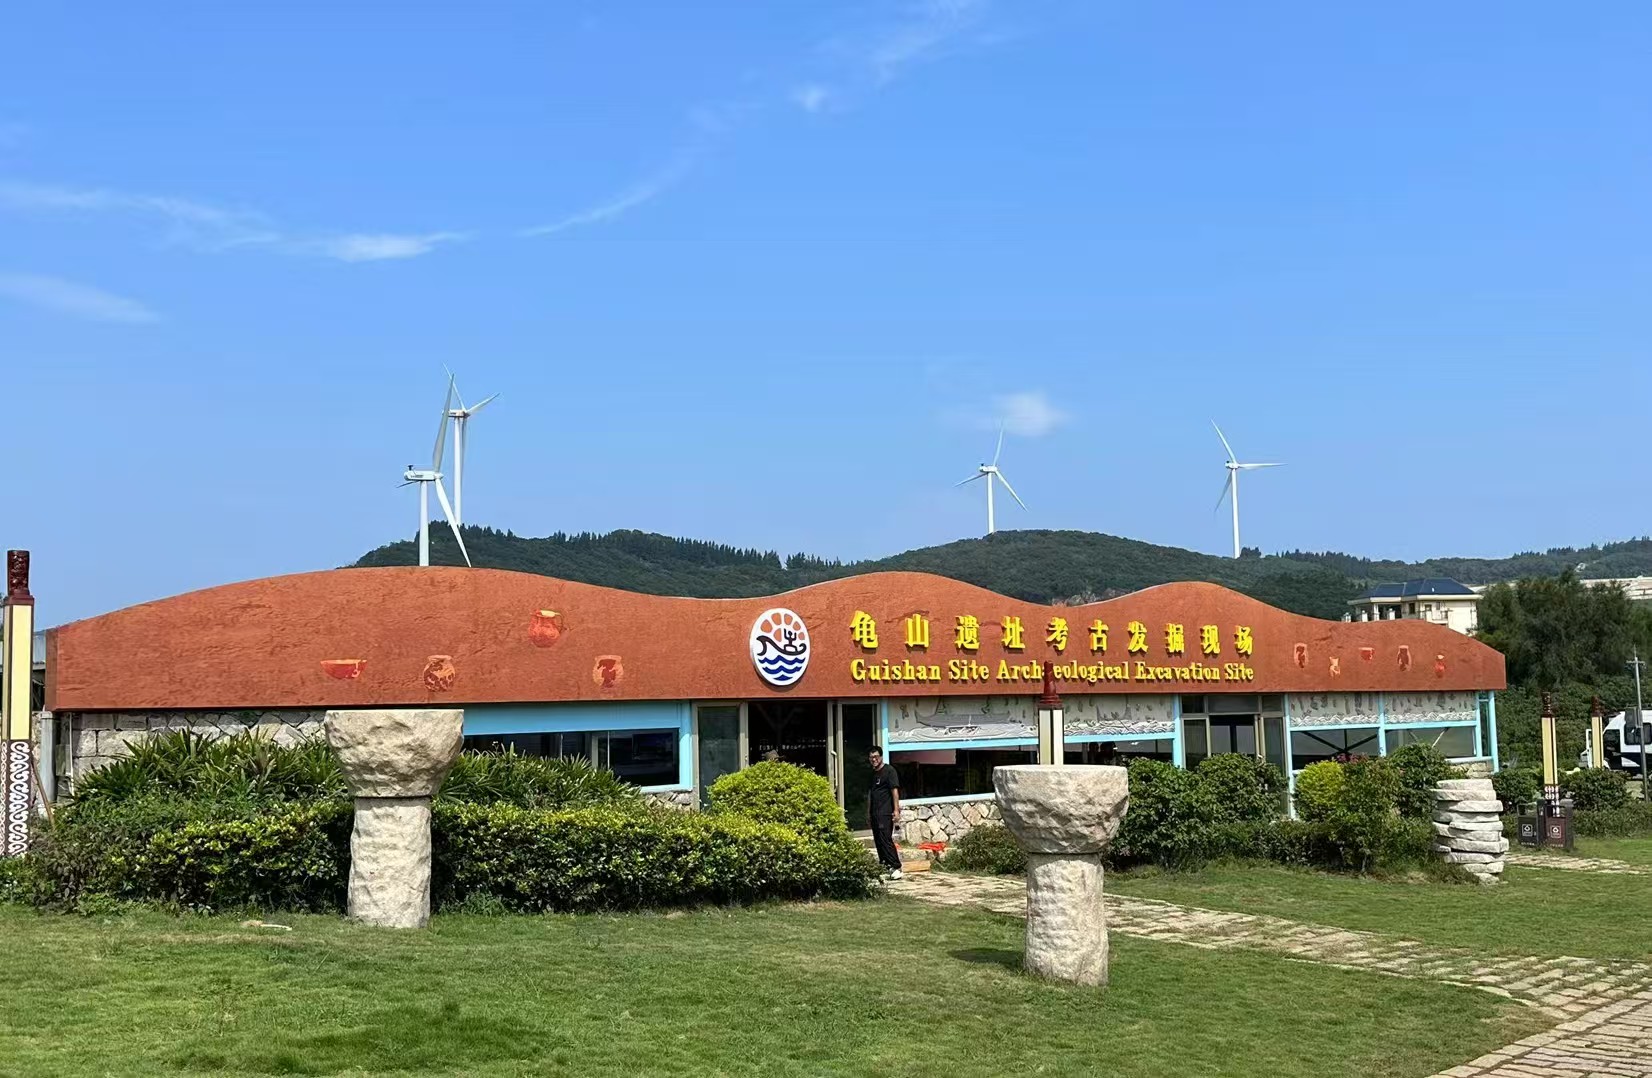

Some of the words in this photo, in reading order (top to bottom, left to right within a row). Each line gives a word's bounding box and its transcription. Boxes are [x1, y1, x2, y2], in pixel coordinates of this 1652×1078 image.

[848, 609, 1254, 655] 龟山遗址考古发掘现场
[850, 658, 942, 681] Guishan
[947, 659, 990, 681] Site
[996, 659, 1130, 684] Archeological
[1133, 660, 1221, 681] Excavation
[1224, 661, 1254, 681] Site
